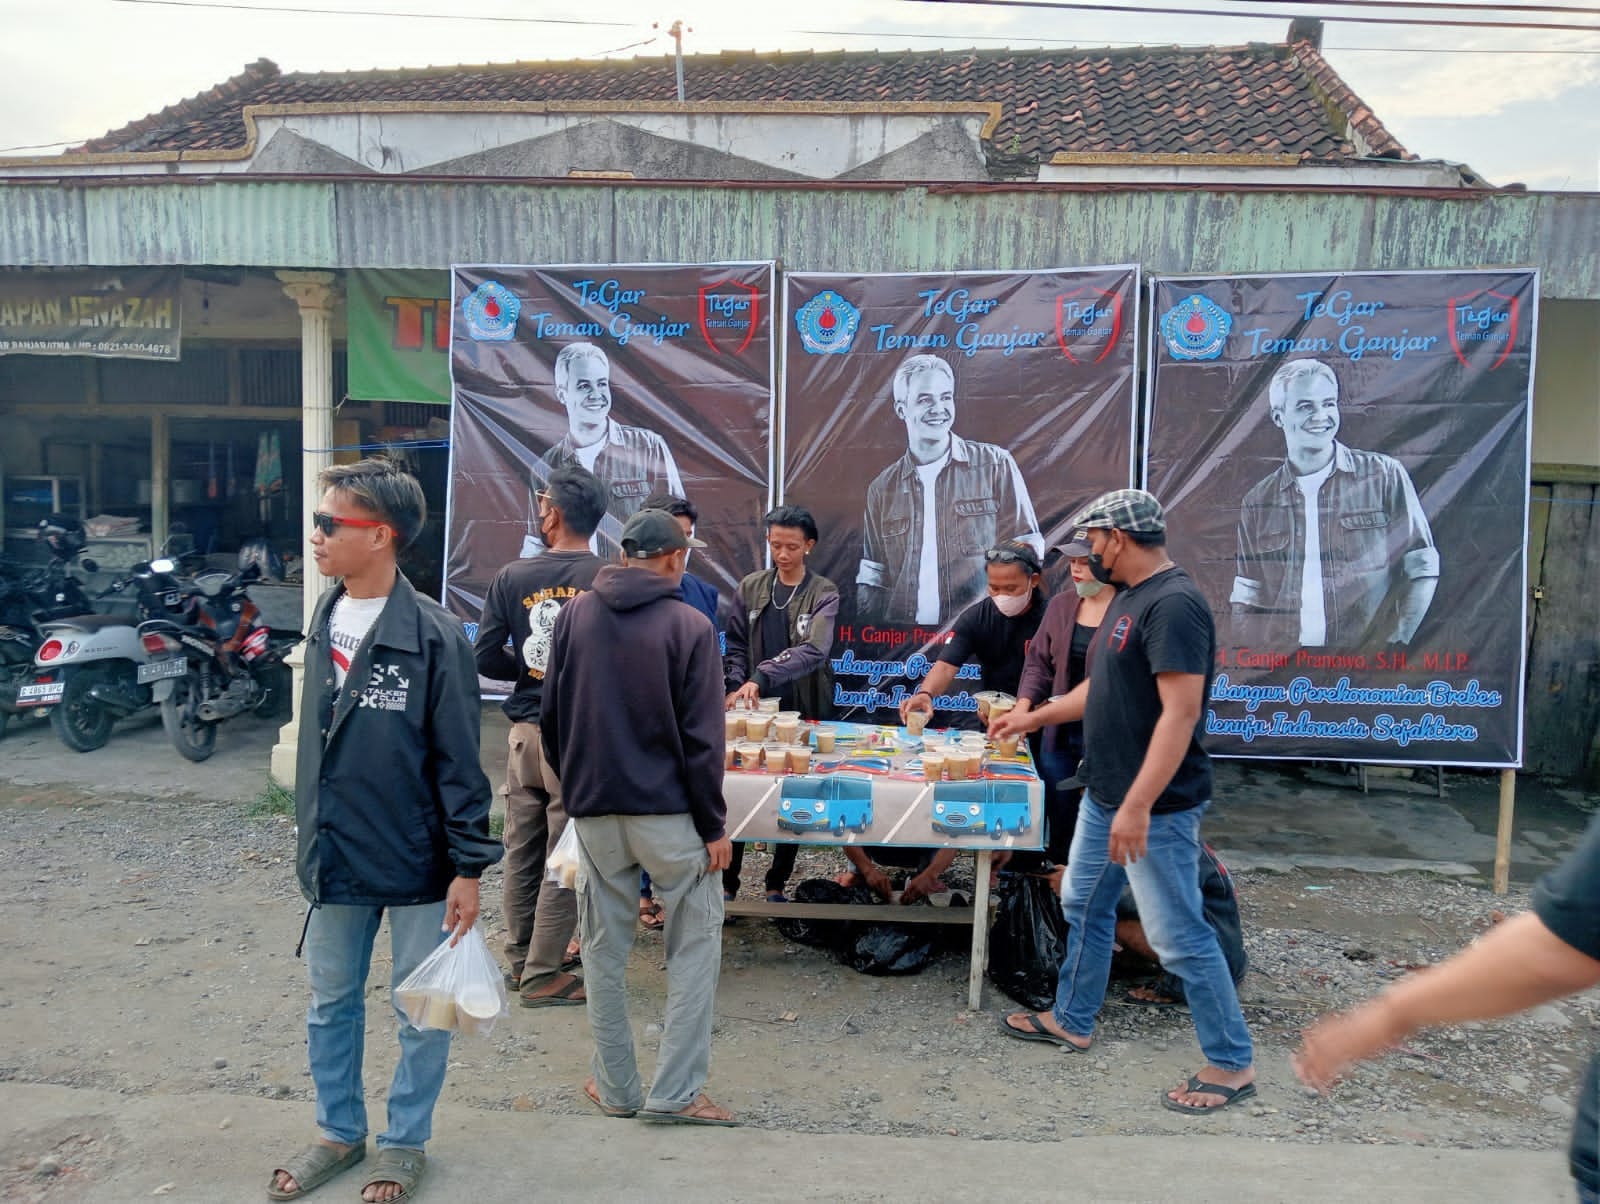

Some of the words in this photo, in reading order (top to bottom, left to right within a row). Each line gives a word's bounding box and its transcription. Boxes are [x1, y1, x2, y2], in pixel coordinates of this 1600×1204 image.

[69, 296, 172, 328] JENAZAH
[573, 279, 645, 313] TeGar
[918, 288, 998, 323] TeGar
[1296, 290, 1384, 326] TeGar
[529, 312, 604, 338] Teman
[608, 313, 691, 345] Ganjar
[870, 324, 949, 351] Teman
[955, 322, 1046, 356] Ganjar
[1243, 328, 1334, 356] Teman
[1339, 325, 1438, 361] Ganjar
[839, 625, 856, 642] H.
[862, 625, 908, 649] Ganjar
[1236, 648, 1290, 672] Ganjar
[1288, 676, 1428, 705] Perekonomian
[1427, 679, 1501, 707] Brebes
[1268, 710, 1369, 740] Indonesia
[1371, 713, 1479, 747] Sejahtera
